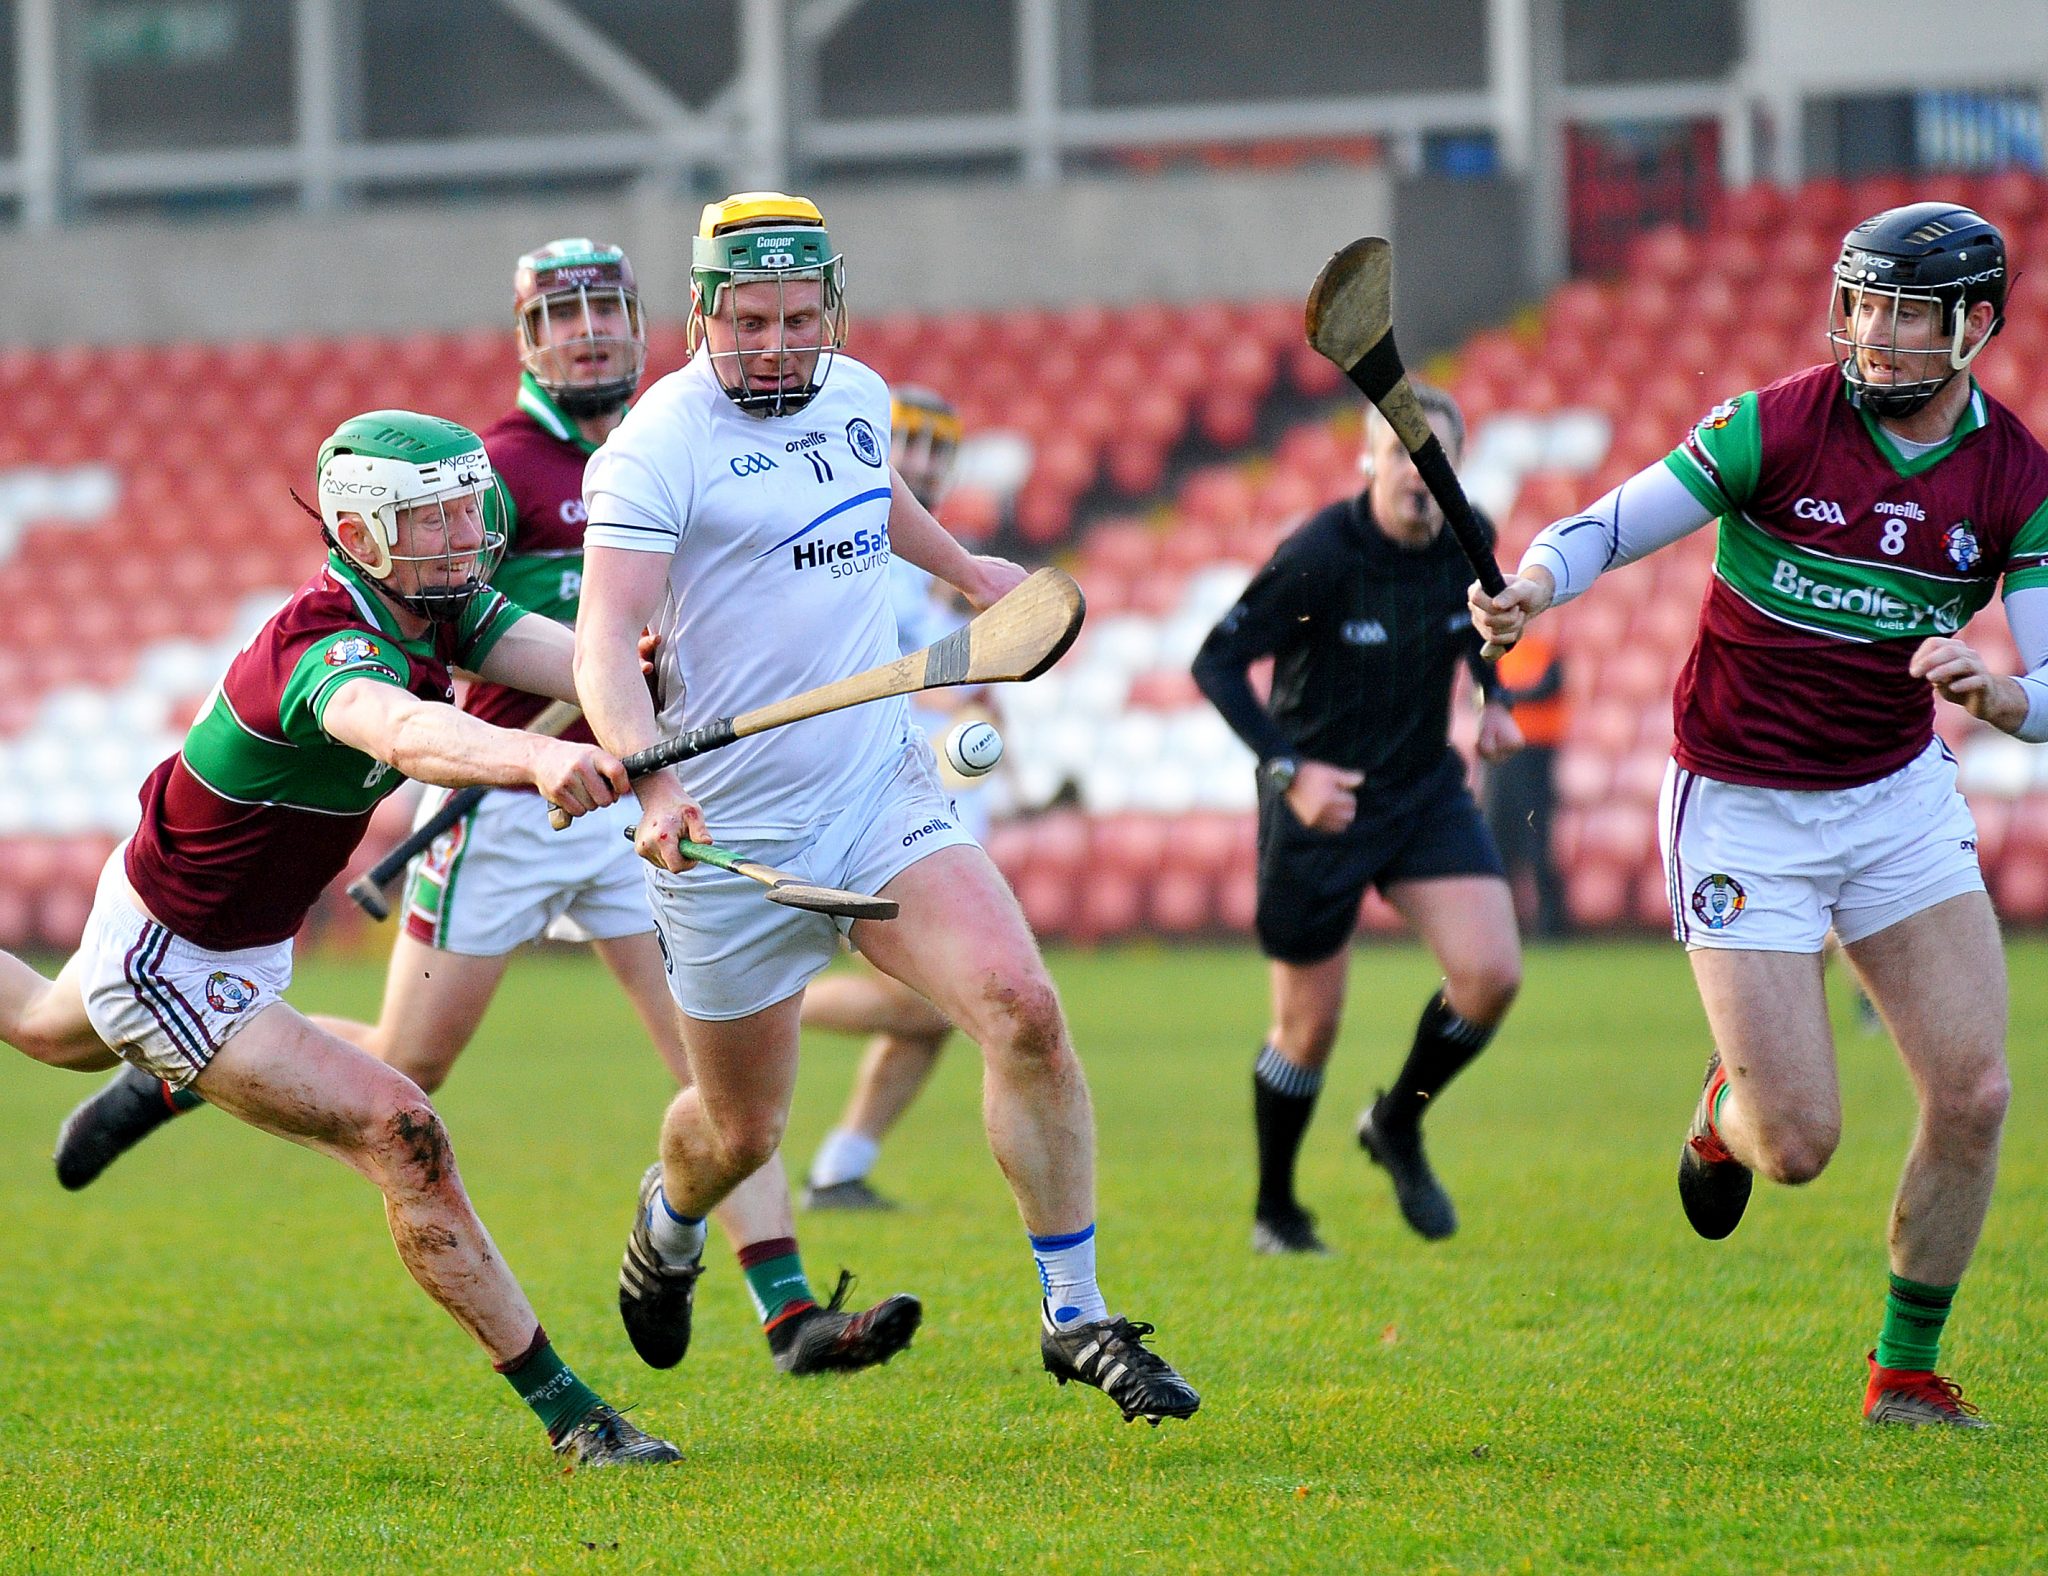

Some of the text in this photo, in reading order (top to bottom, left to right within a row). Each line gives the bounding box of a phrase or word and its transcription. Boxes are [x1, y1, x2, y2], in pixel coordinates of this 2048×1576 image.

[757, 236, 795, 249] Cooper
[803, 450, 834, 484] 11
[793, 523, 888, 571] HireSaf
[1880, 518, 1907, 555] 8
[1772, 559, 1934, 630] Bradley
